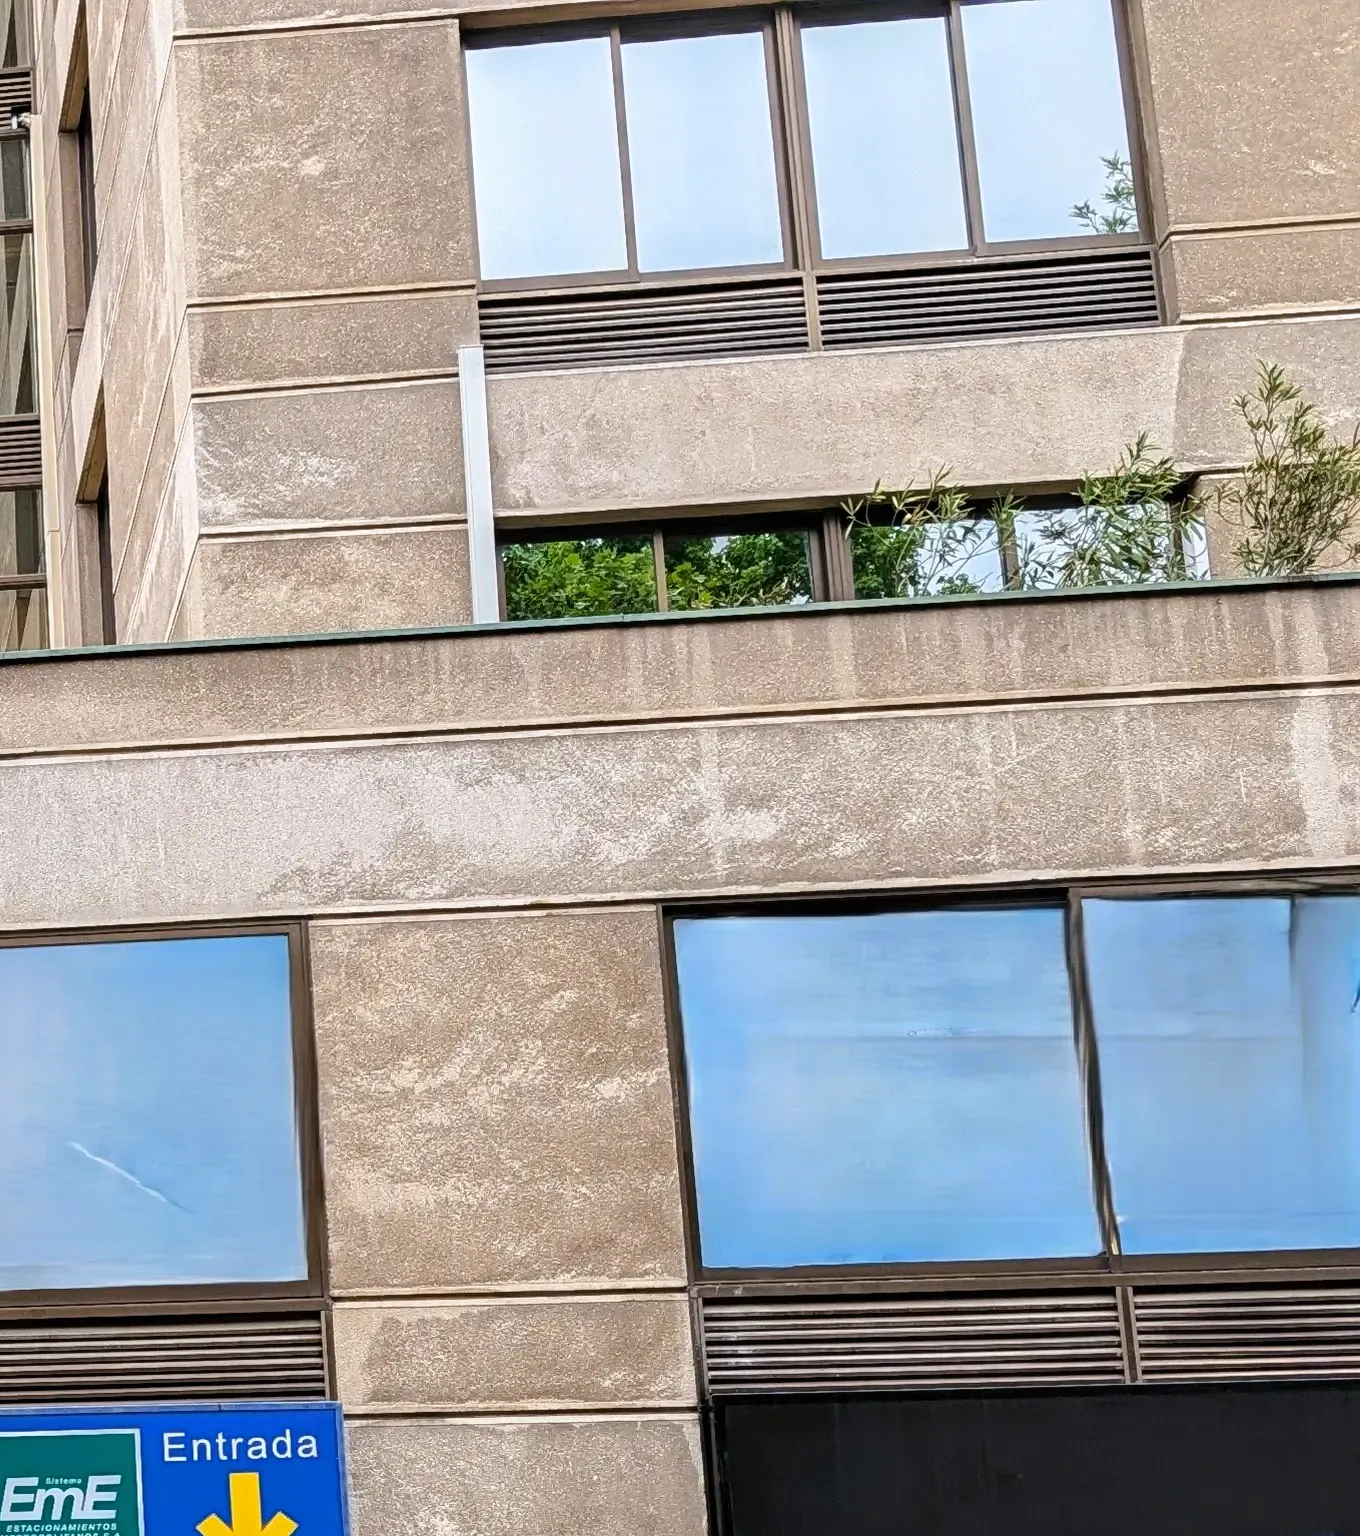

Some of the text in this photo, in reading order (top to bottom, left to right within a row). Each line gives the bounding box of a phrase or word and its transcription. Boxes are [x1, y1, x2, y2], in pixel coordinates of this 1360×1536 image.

[162, 1428, 319, 1462] Entrada
[0, 1474, 122, 1522] EmE
[6, 1522, 117, 1533] ESTACIONAMIENTOS
